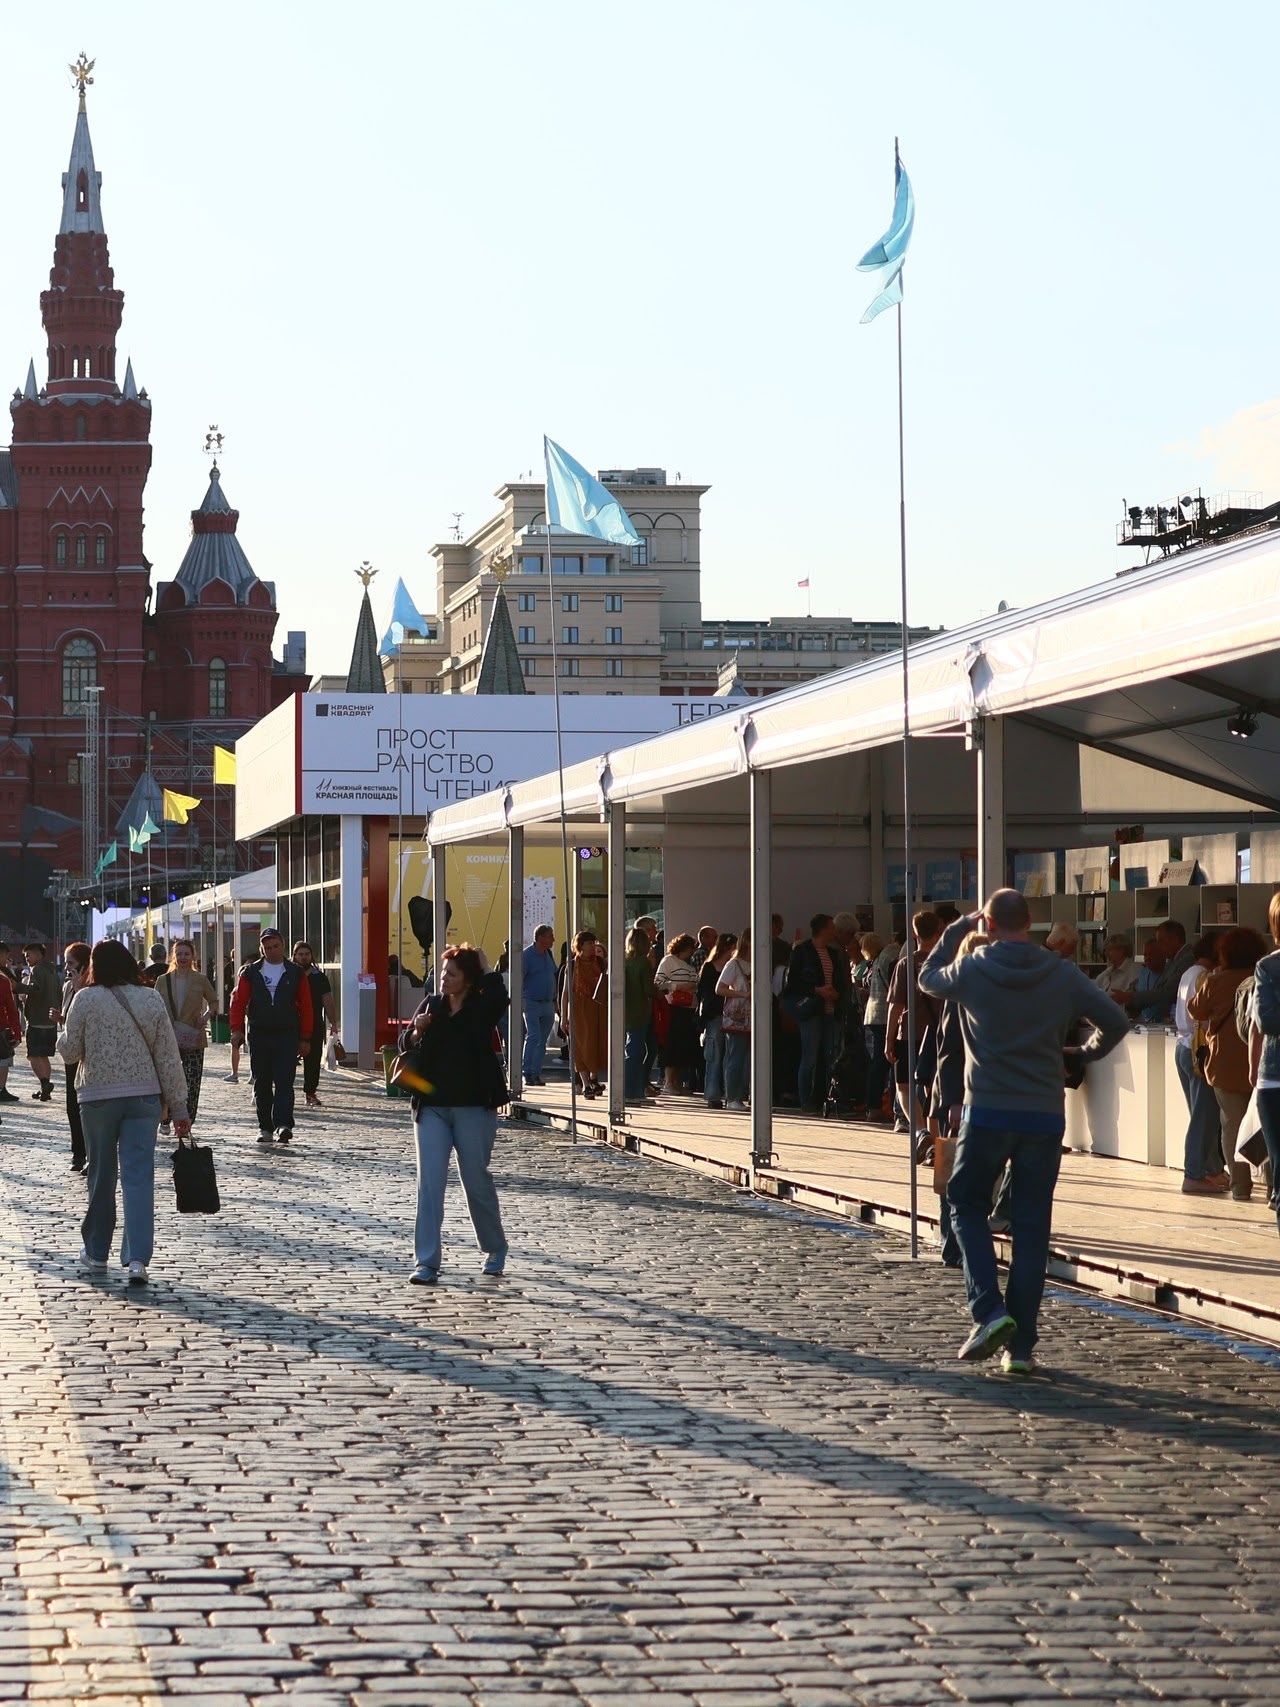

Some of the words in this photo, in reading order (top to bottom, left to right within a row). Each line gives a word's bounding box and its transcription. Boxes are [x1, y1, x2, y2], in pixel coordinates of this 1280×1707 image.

[672, 703, 741, 726] ТЕР
[377, 728, 460, 750] ПРОСТ
[377, 752, 494, 775] РАНСТВО
[315, 778, 333, 792] 11
[424, 779, 519, 800] ЧТЕНИ
[315, 792, 355, 800] КРАСНАЯ
[355, 792, 399, 801] ПЛОЩАДЬ
